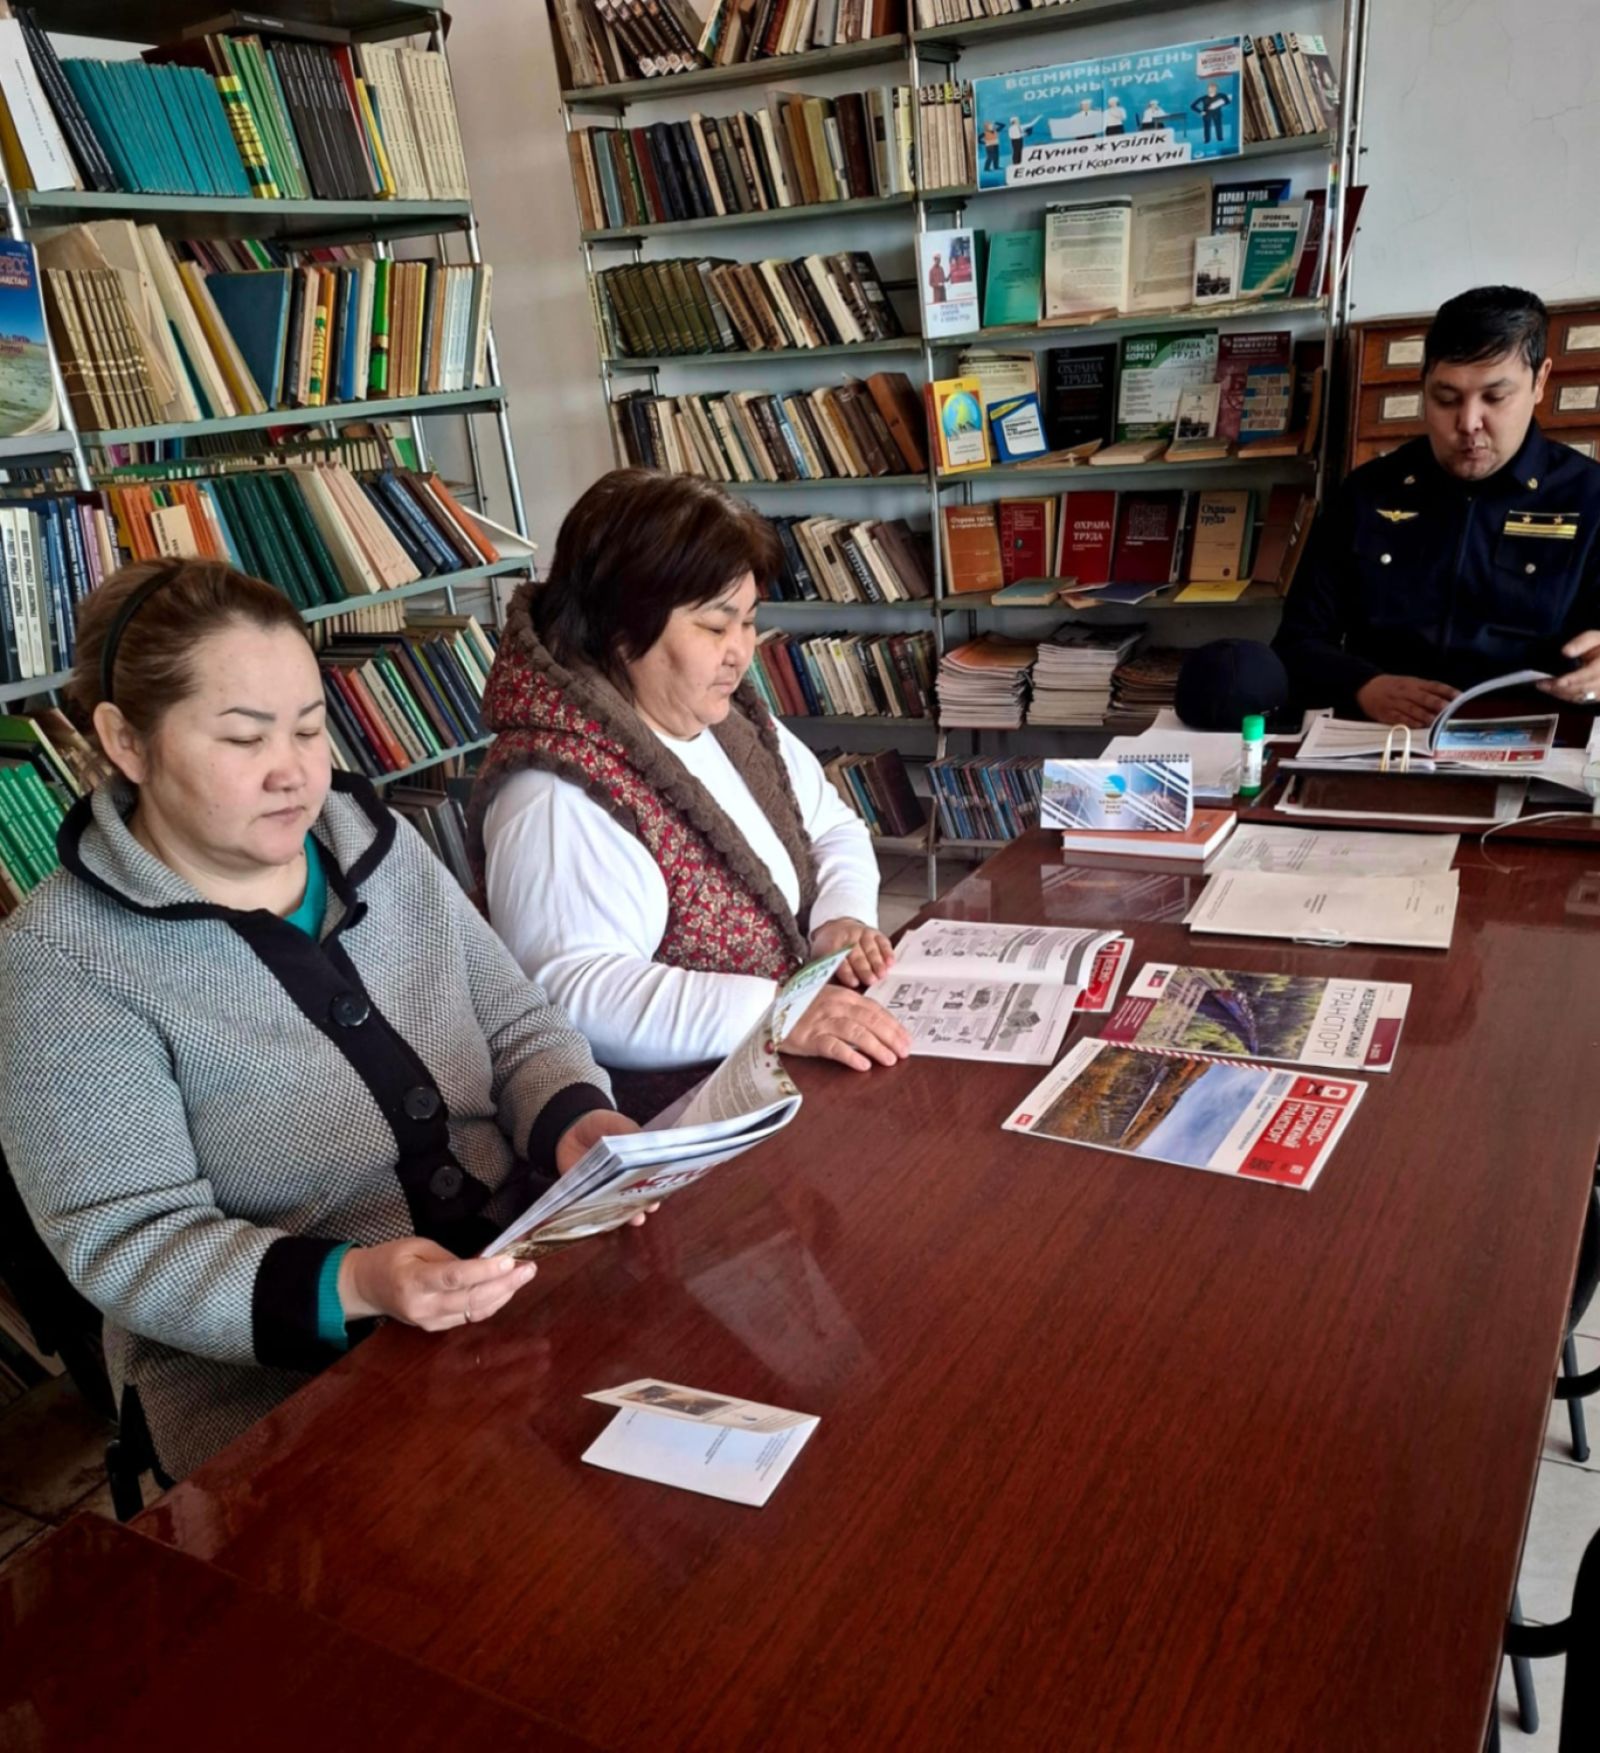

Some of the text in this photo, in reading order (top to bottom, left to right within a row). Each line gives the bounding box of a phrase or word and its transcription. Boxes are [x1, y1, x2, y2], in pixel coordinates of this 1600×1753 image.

[1004, 51, 1193, 90] ВСЕМИРНЫЙ ДЕНЬ
[1024, 68, 1175, 101] ОХРАНЫ ТРУДА
[1027, 143, 1089, 163] Дүние
[1013, 159, 1083, 180] Еңбекті
[1201, 504, 1237, 516] Охрана
[1073, 520, 1110, 530] ОХРАНА
[1200, 515, 1226, 527] труда
[1073, 531, 1104, 542] ТРУДА
[1312, 986, 1357, 1057] ТРАНСПОРТ
